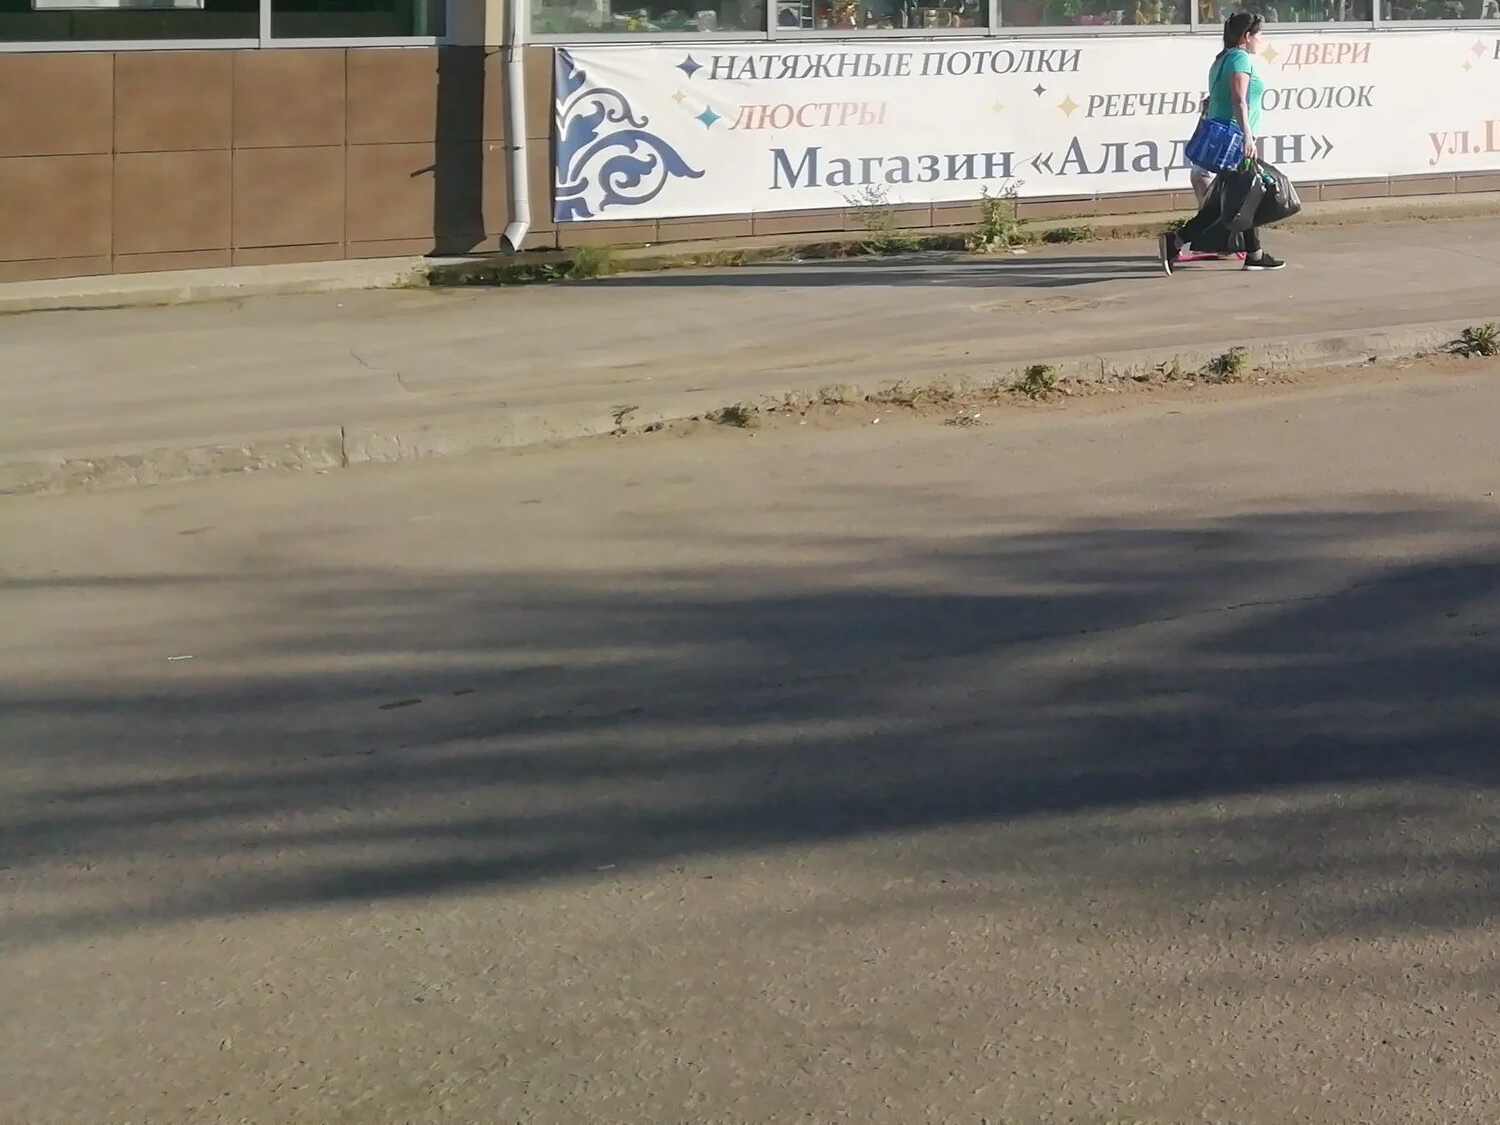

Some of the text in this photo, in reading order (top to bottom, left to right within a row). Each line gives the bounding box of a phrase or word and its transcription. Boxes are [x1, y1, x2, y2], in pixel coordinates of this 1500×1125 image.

[708, 47, 1083, 81] НАТЯЖНЫЕ ПОТОЛКИ
[1282, 42, 1371, 71] ДВЕРИ
[727, 100, 888, 132] ЛЮСТРЫ
[1085, 84, 1375, 119] РЕЕЧНЫ ОТОЛОК
[768, 143, 1015, 192] Магазин
